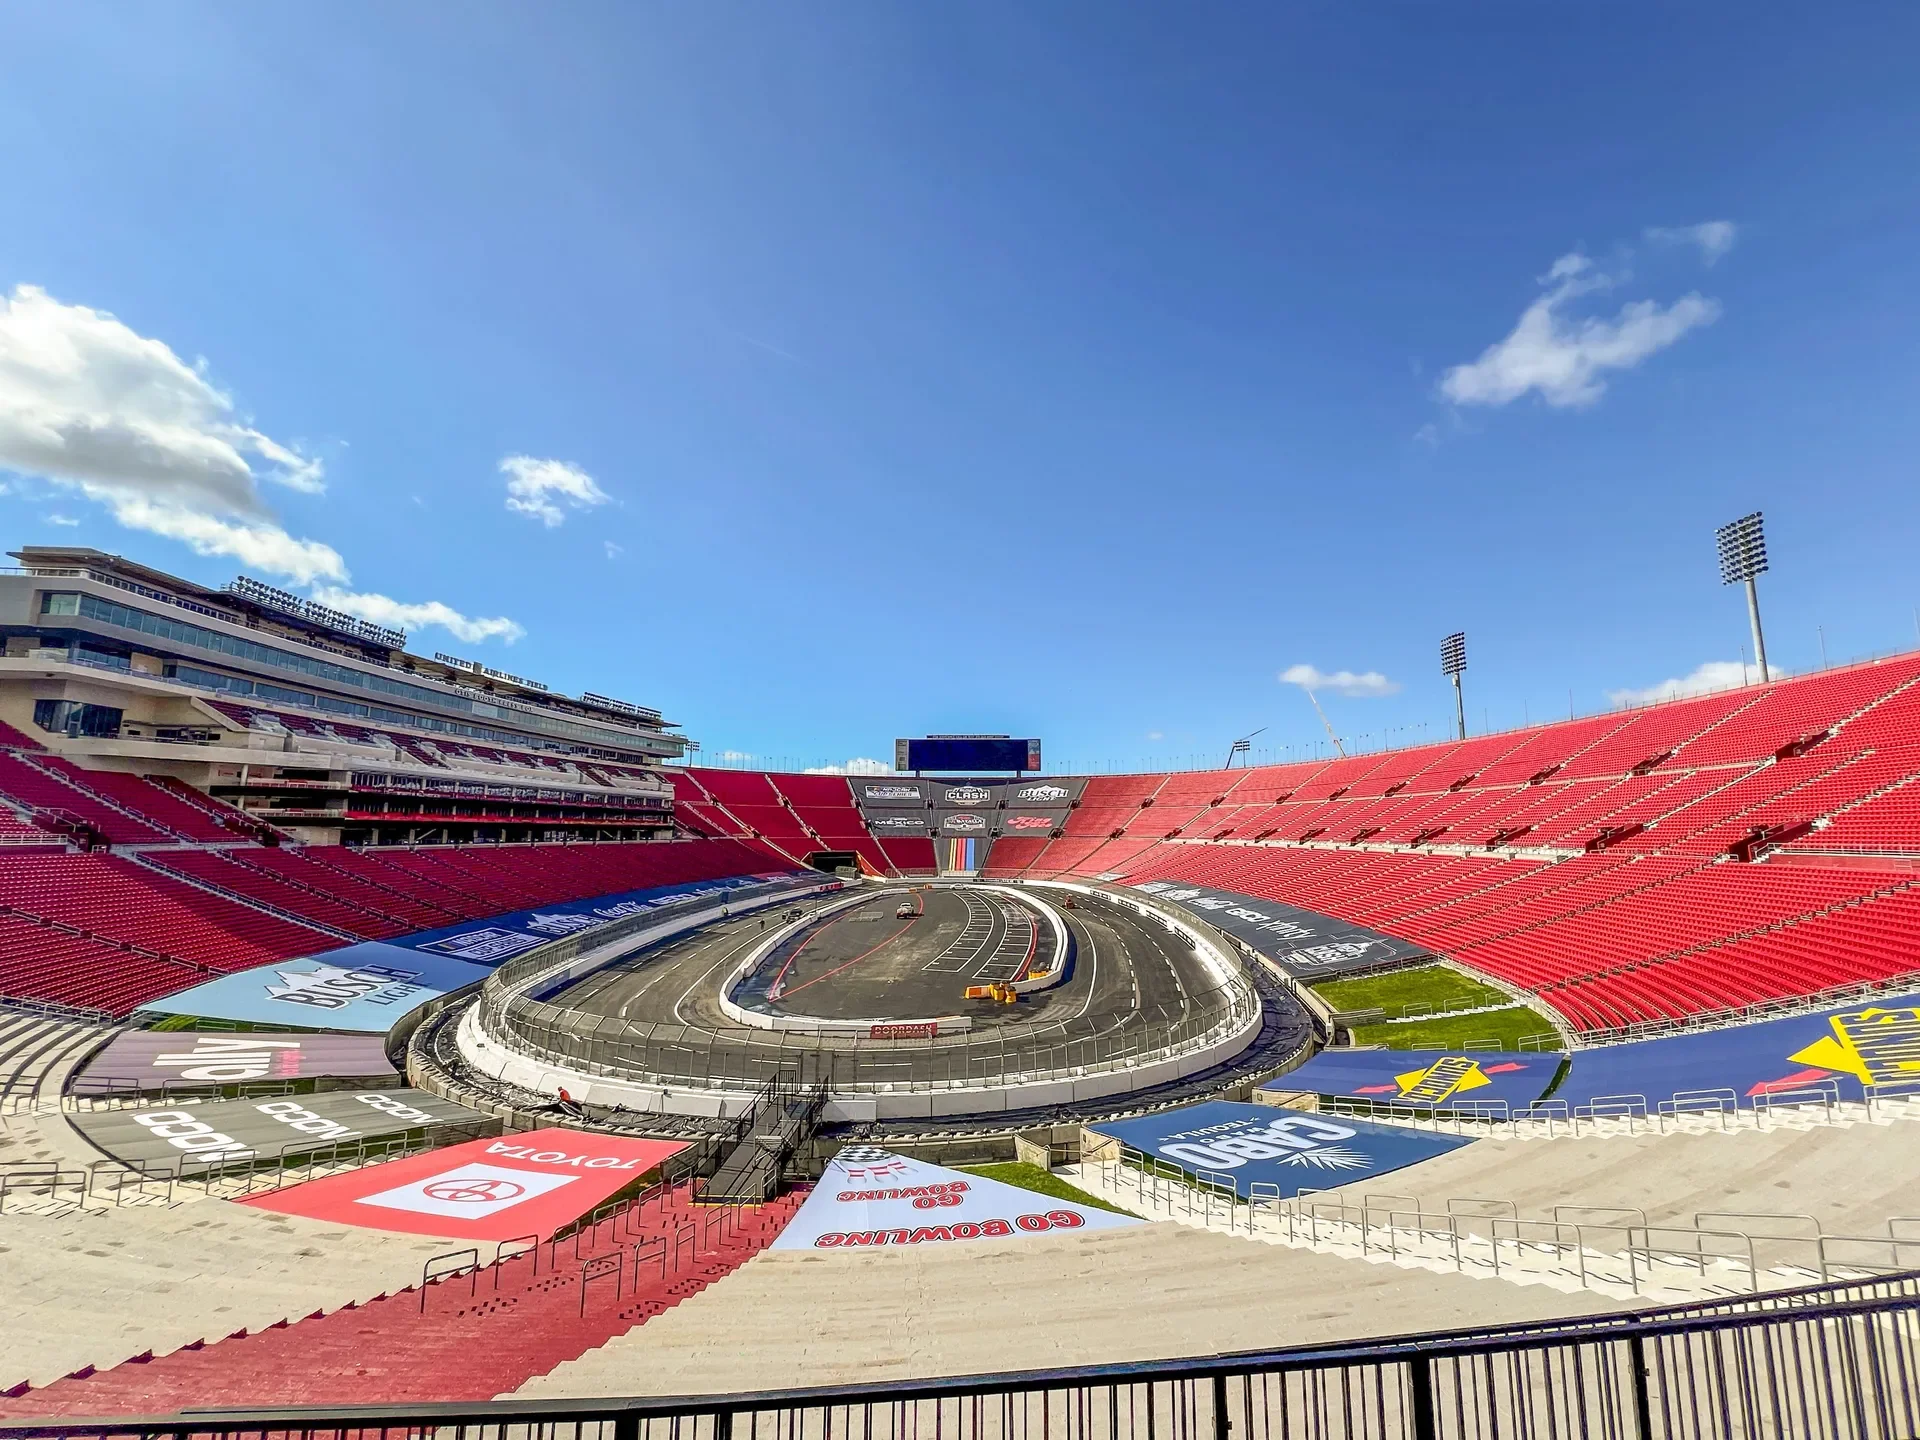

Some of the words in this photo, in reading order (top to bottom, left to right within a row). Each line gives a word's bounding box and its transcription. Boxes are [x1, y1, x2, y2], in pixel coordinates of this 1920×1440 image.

[434, 652, 472, 669] UNITED
[483, 667, 523, 683] AIRLINES
[526, 679, 549, 691] FIELD
[1018, 789, 1068, 797] BUSCH
[270, 964, 425, 1010] BUSCH
[364, 981, 432, 1006] LIGHT
[875, 1025, 932, 1034] DOORDASH
[153, 1037, 300, 1080] ally
[1402, 1058, 1475, 1100] SUNOCO
[256, 1101, 363, 1140] NOCO
[355, 1093, 445, 1124] NOCO
[132, 1110, 261, 1162] NOCO
[1158, 1116, 1357, 1169] CABO
[1171, 1119, 1252, 1141] TEQUILA
[1200, 1127, 1265, 1143] WABO
[485, 1141, 642, 1169] TOYOTA
[837, 1181, 971, 1202] BOWLING
[913, 1193, 963, 1209] GO
[815, 1219, 1015, 1248] BOWLING
[1015, 1210, 1085, 1232] GO
